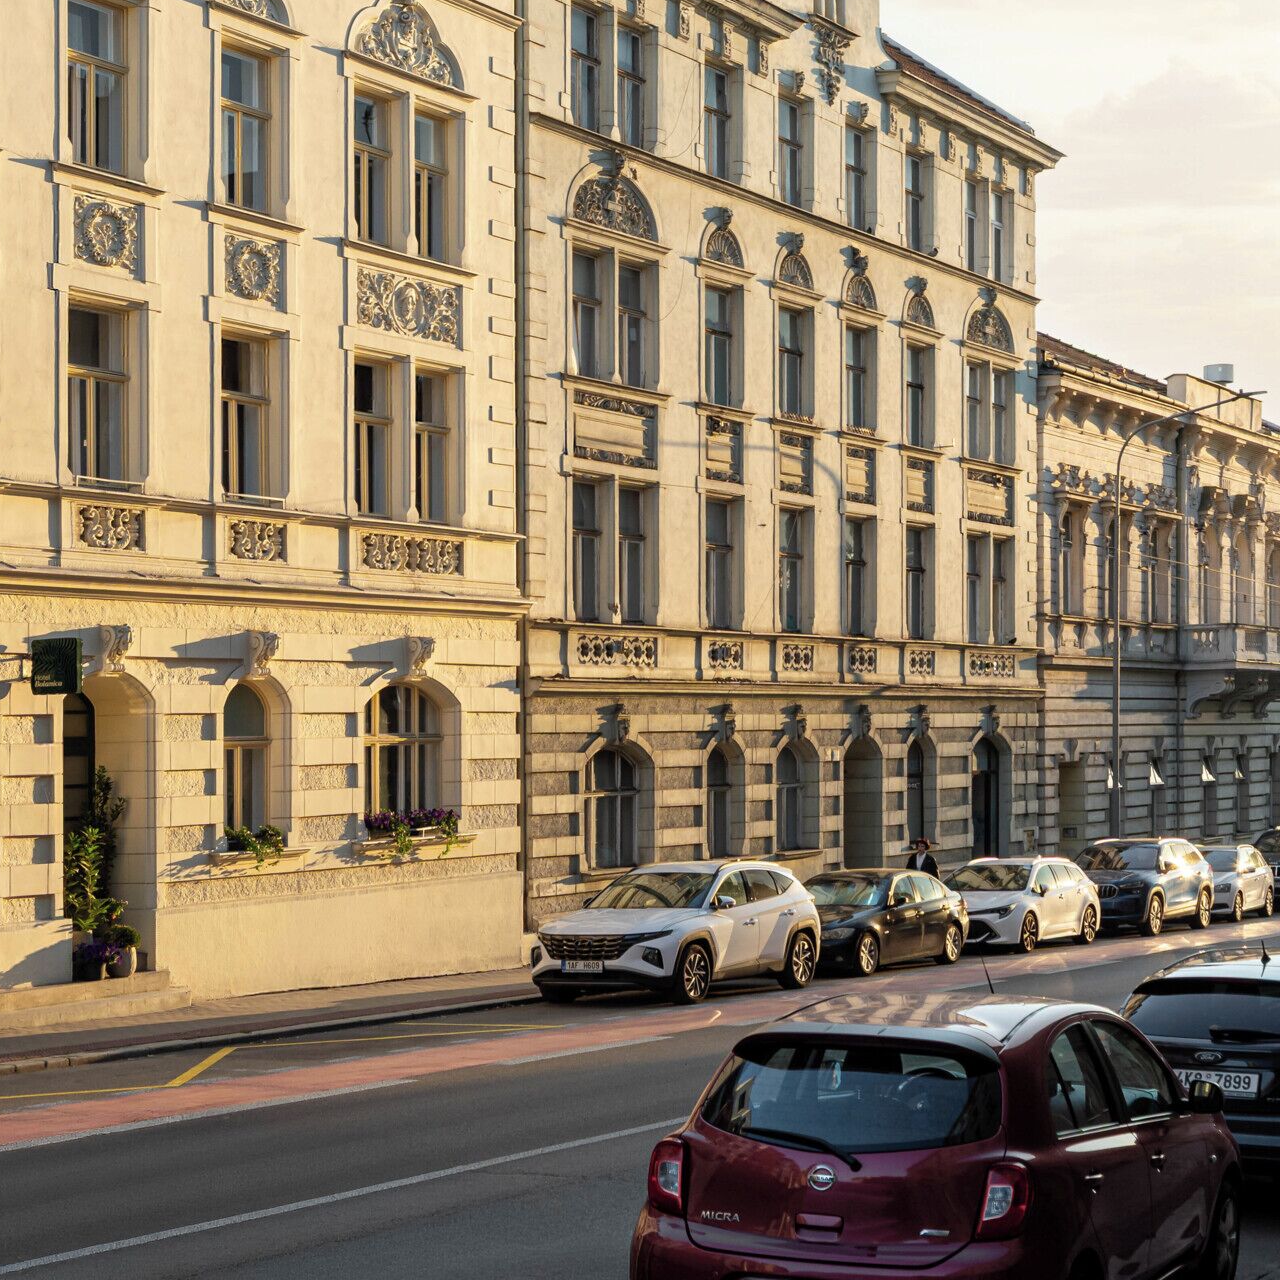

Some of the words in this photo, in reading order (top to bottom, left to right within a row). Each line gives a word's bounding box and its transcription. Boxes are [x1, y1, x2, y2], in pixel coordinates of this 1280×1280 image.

[567, 961, 579, 970] 1AF
[583, 961, 600, 970] H609
[1214, 1073, 1252, 1090] 7899
[700, 1210, 740, 1222] MICRA
